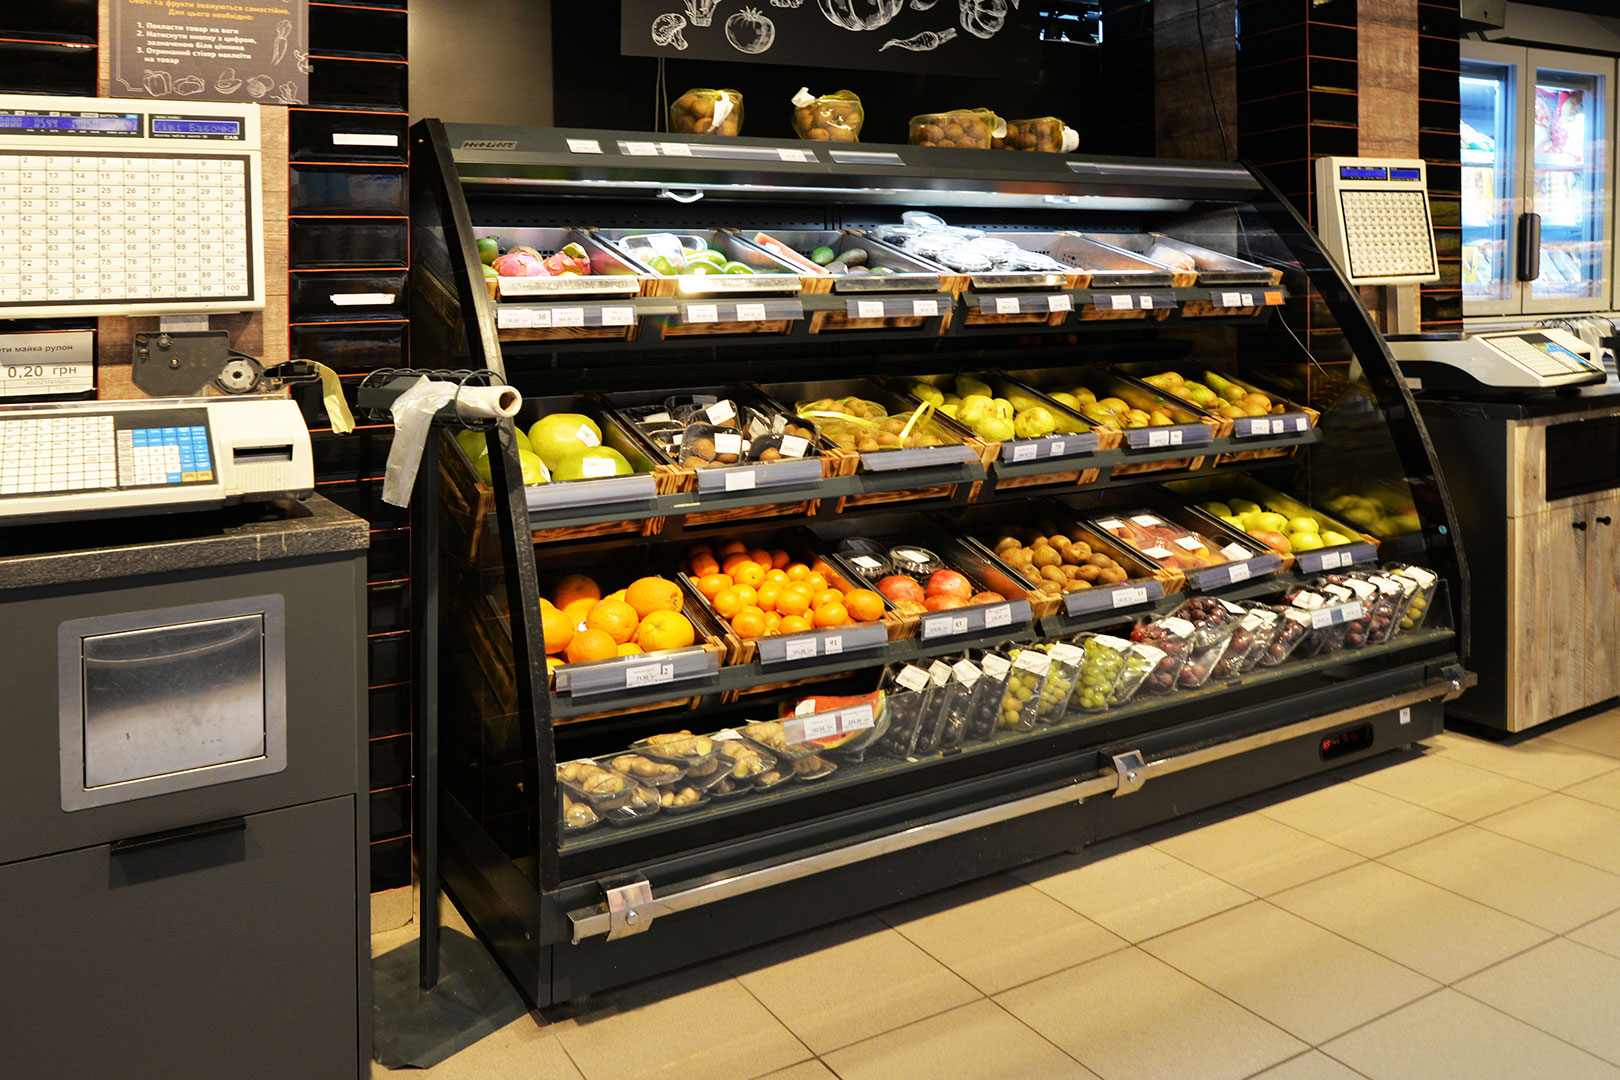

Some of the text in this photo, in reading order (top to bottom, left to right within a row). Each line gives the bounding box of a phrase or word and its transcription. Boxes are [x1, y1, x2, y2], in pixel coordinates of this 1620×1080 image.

[168, 8, 185, 16] Для
[146, 22, 184, 30] Покласти
[45, 345, 73, 353] рулон
[8, 365, 77, 380] 0,20 грн
